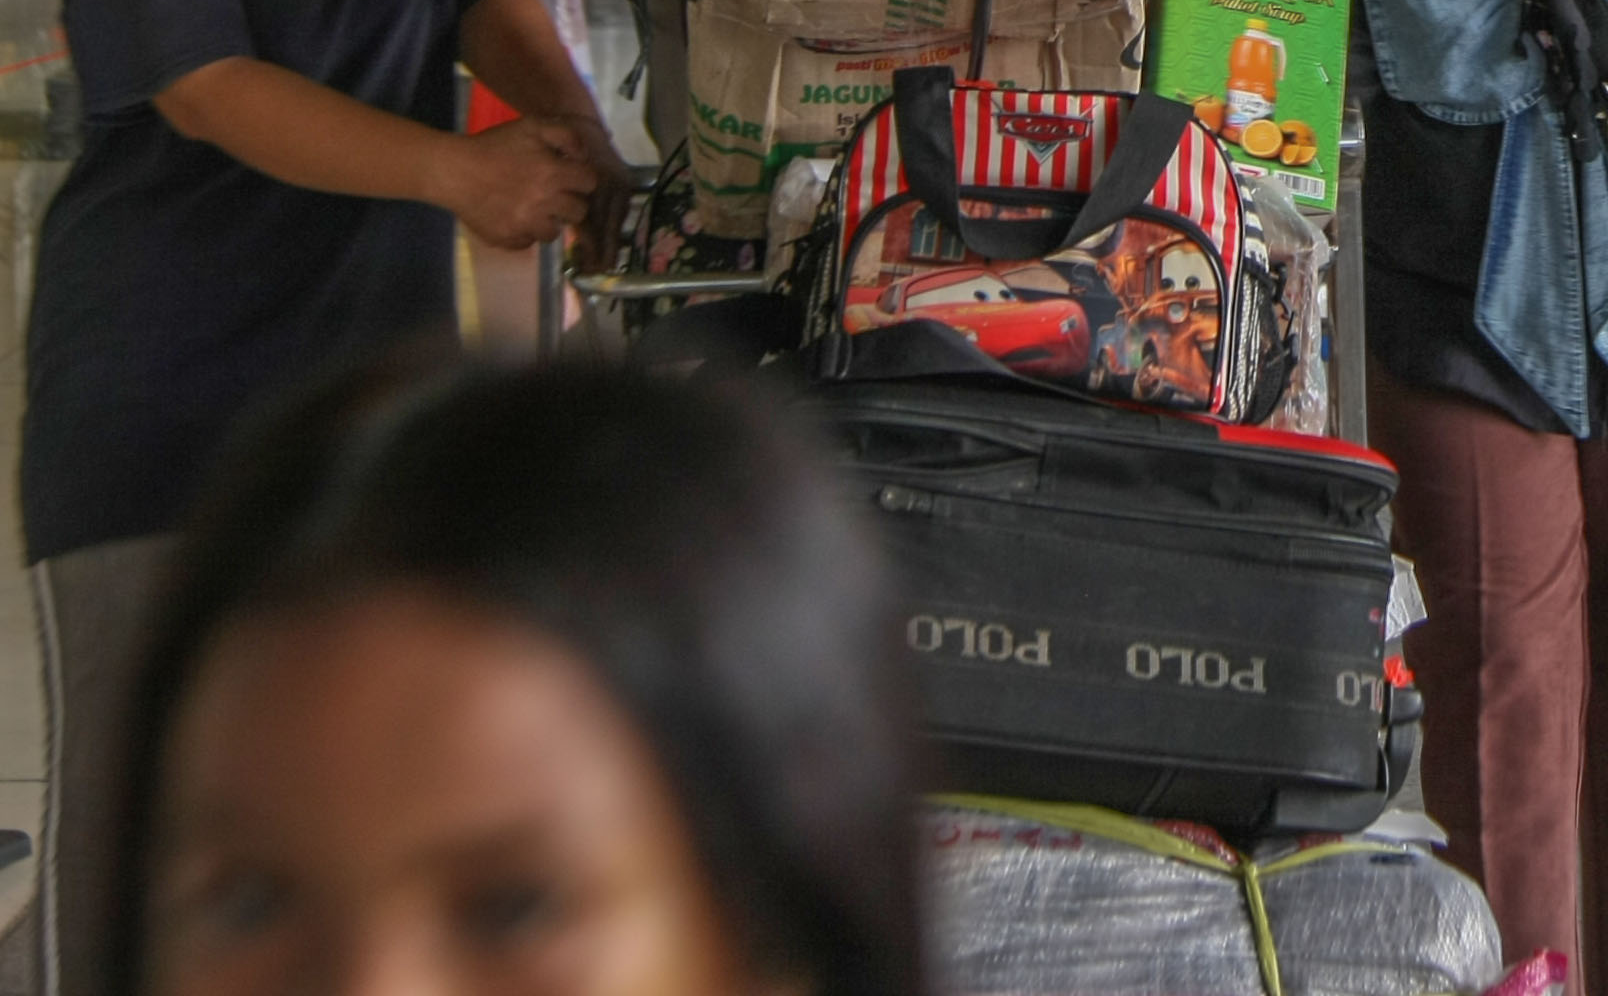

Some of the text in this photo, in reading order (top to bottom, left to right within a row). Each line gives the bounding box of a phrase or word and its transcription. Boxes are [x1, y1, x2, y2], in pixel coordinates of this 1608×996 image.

[800, 83, 894, 104] JAGUN
[906, 614, 1052, 667] POLO
[1125, 641, 1268, 694] POLO
